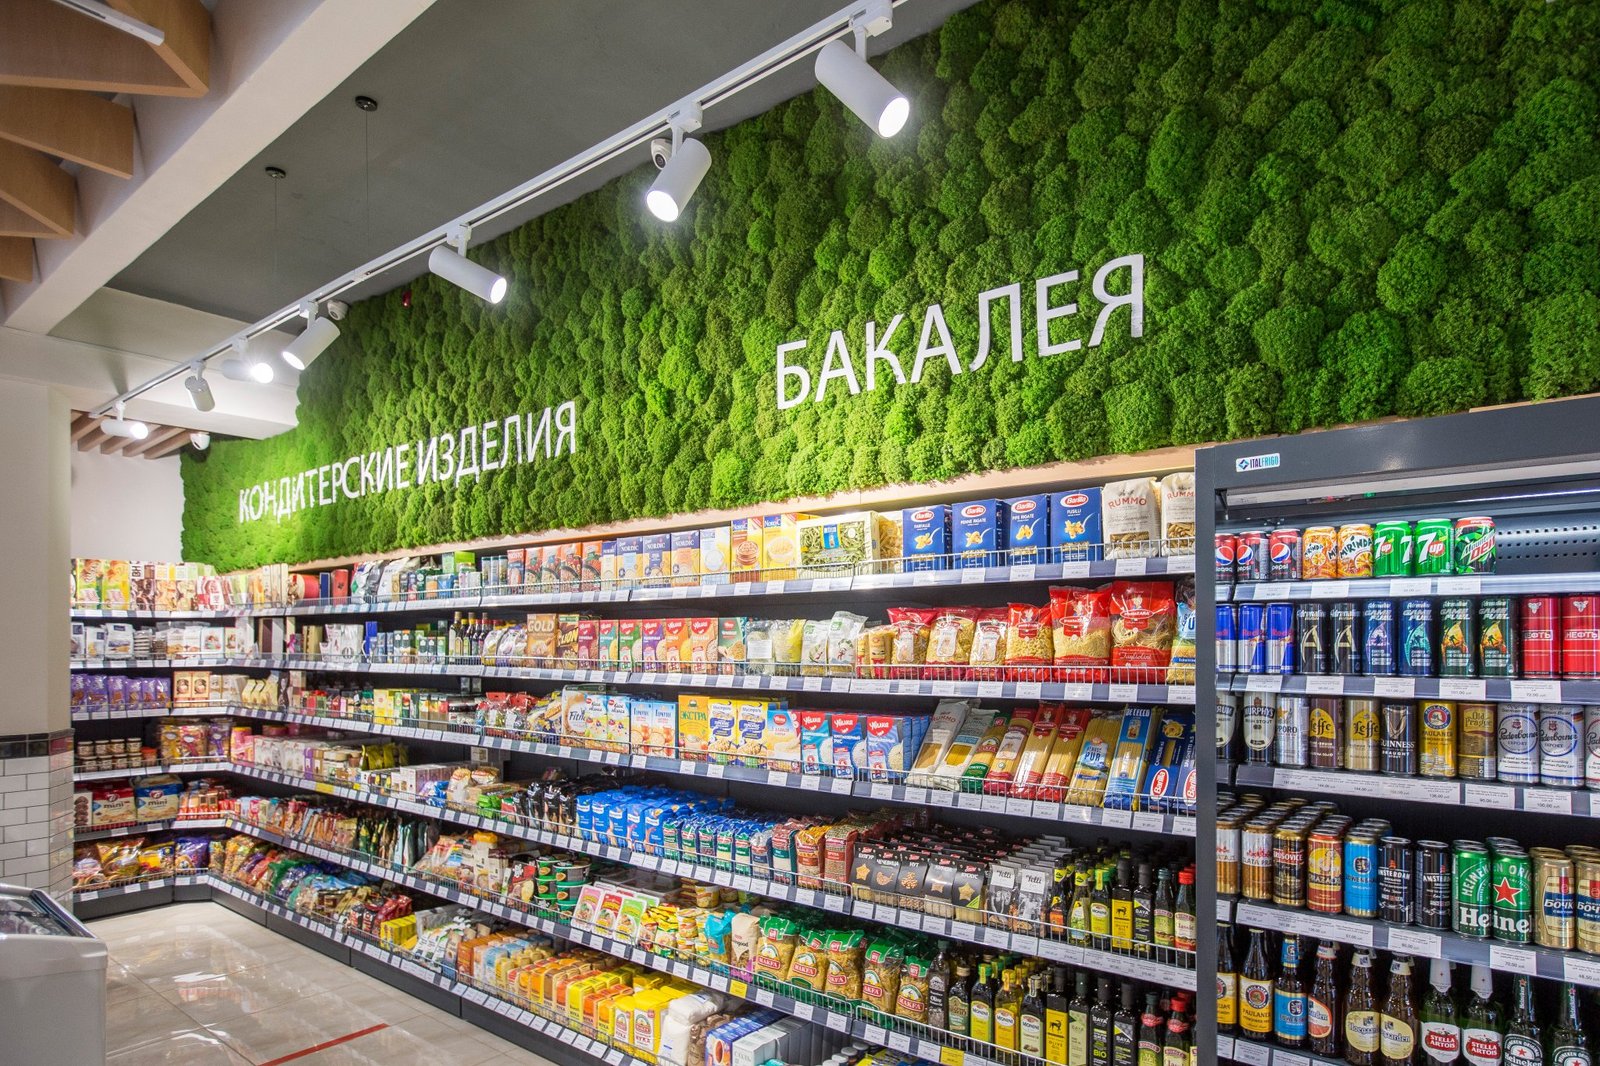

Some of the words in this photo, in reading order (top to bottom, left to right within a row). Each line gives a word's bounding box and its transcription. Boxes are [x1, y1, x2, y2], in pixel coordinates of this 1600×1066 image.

[776, 253, 1145, 410] БАКАЛЕЯ
[238, 443, 410, 524] КОНДИТЕРСКИЕ
[416, 400, 576, 488] ИЗДЕЛИЯ
[1250, 456, 1279, 469] ITALFRIGO
[1066, 496, 1088, 505] Barilla
[1108, 497, 1147, 509] RUMMO
[967, 507, 985, 515] Barilla
[1017, 502, 1035, 511] Barilla
[915, 512, 933, 521] Barilla
[1340, 534, 1373, 559] MIRINDA
[527, 620, 555, 632] GOLD
[1566, 630, 1598, 640] НЕФТЬ
[680, 711, 707, 721] ЭКСТРА
[1353, 717, 1379, 738] Leffe
[1085, 752, 1102, 761] PUR
[1154, 771, 1166, 794] Barilla
[1430, 1034, 1455, 1044] STELLA
[1430, 1040, 1456, 1049] ARTOIS
[1471, 1041, 1497, 1050] STELLA
[1093, 1049, 1107, 1058] BIO
[1471, 1047, 1498, 1056] ARTOIS
